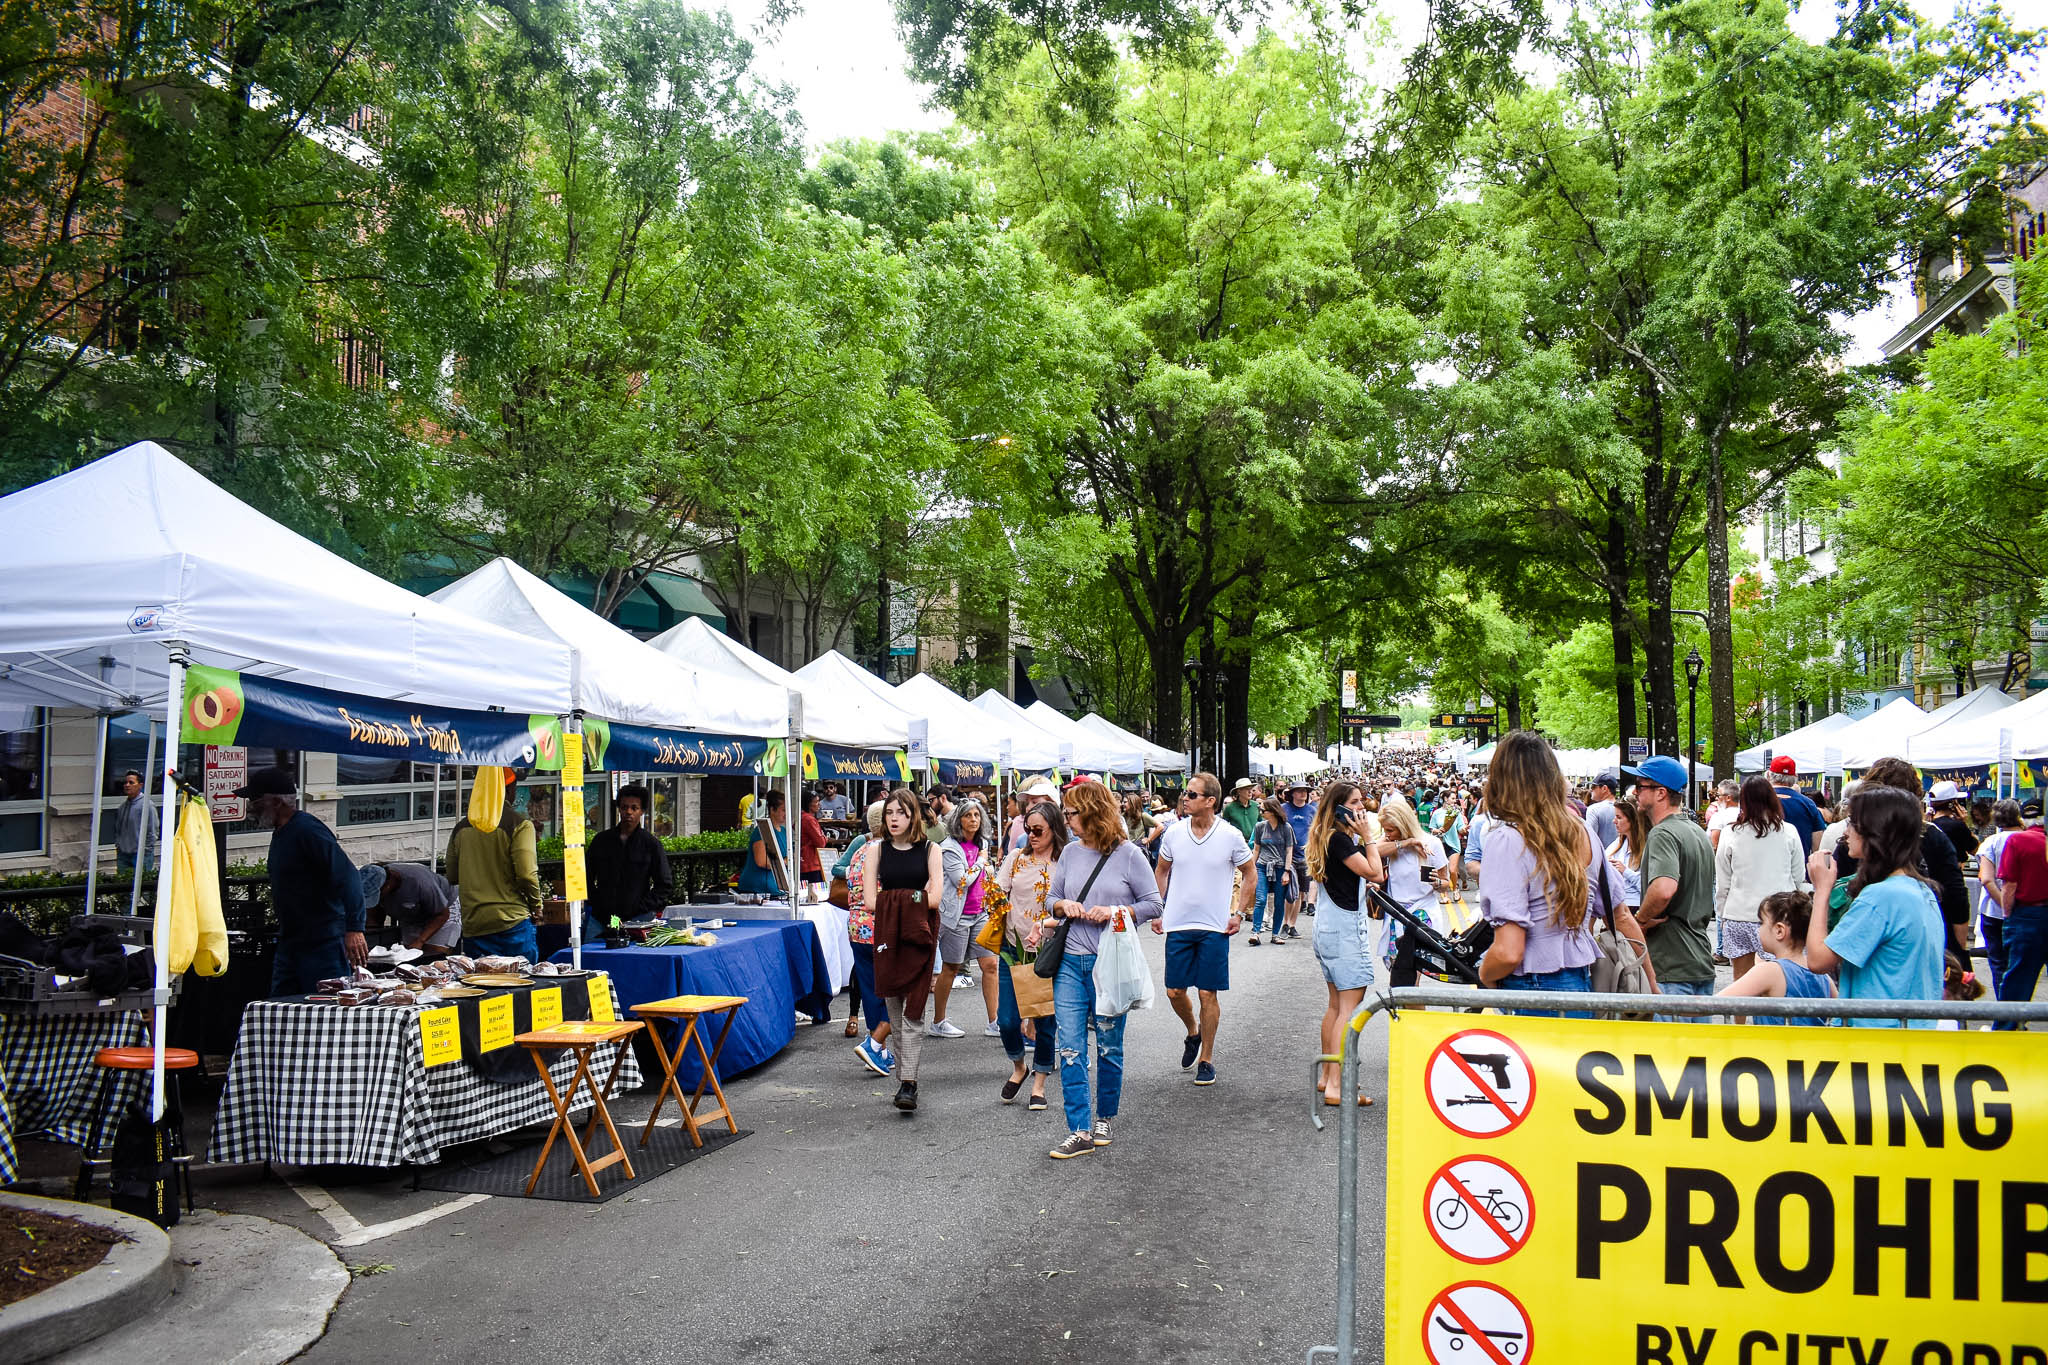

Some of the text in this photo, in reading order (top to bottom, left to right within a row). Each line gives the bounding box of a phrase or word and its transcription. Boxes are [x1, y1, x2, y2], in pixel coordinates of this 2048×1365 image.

[338, 707, 463, 754] Banana Manna
[207, 748, 244, 764] NO PARKING
[652, 736, 700, 766] Jackson
[698, 739, 732, 767] Farms
[208, 770, 243, 780] SATURDAY
[349, 807, 396, 822] Chicken
[1574, 1050, 2013, 1151] SMOKING
[1576, 1162, 2048, 1303] PROHIB
[1637, 1323, 1717, 1365] BY
